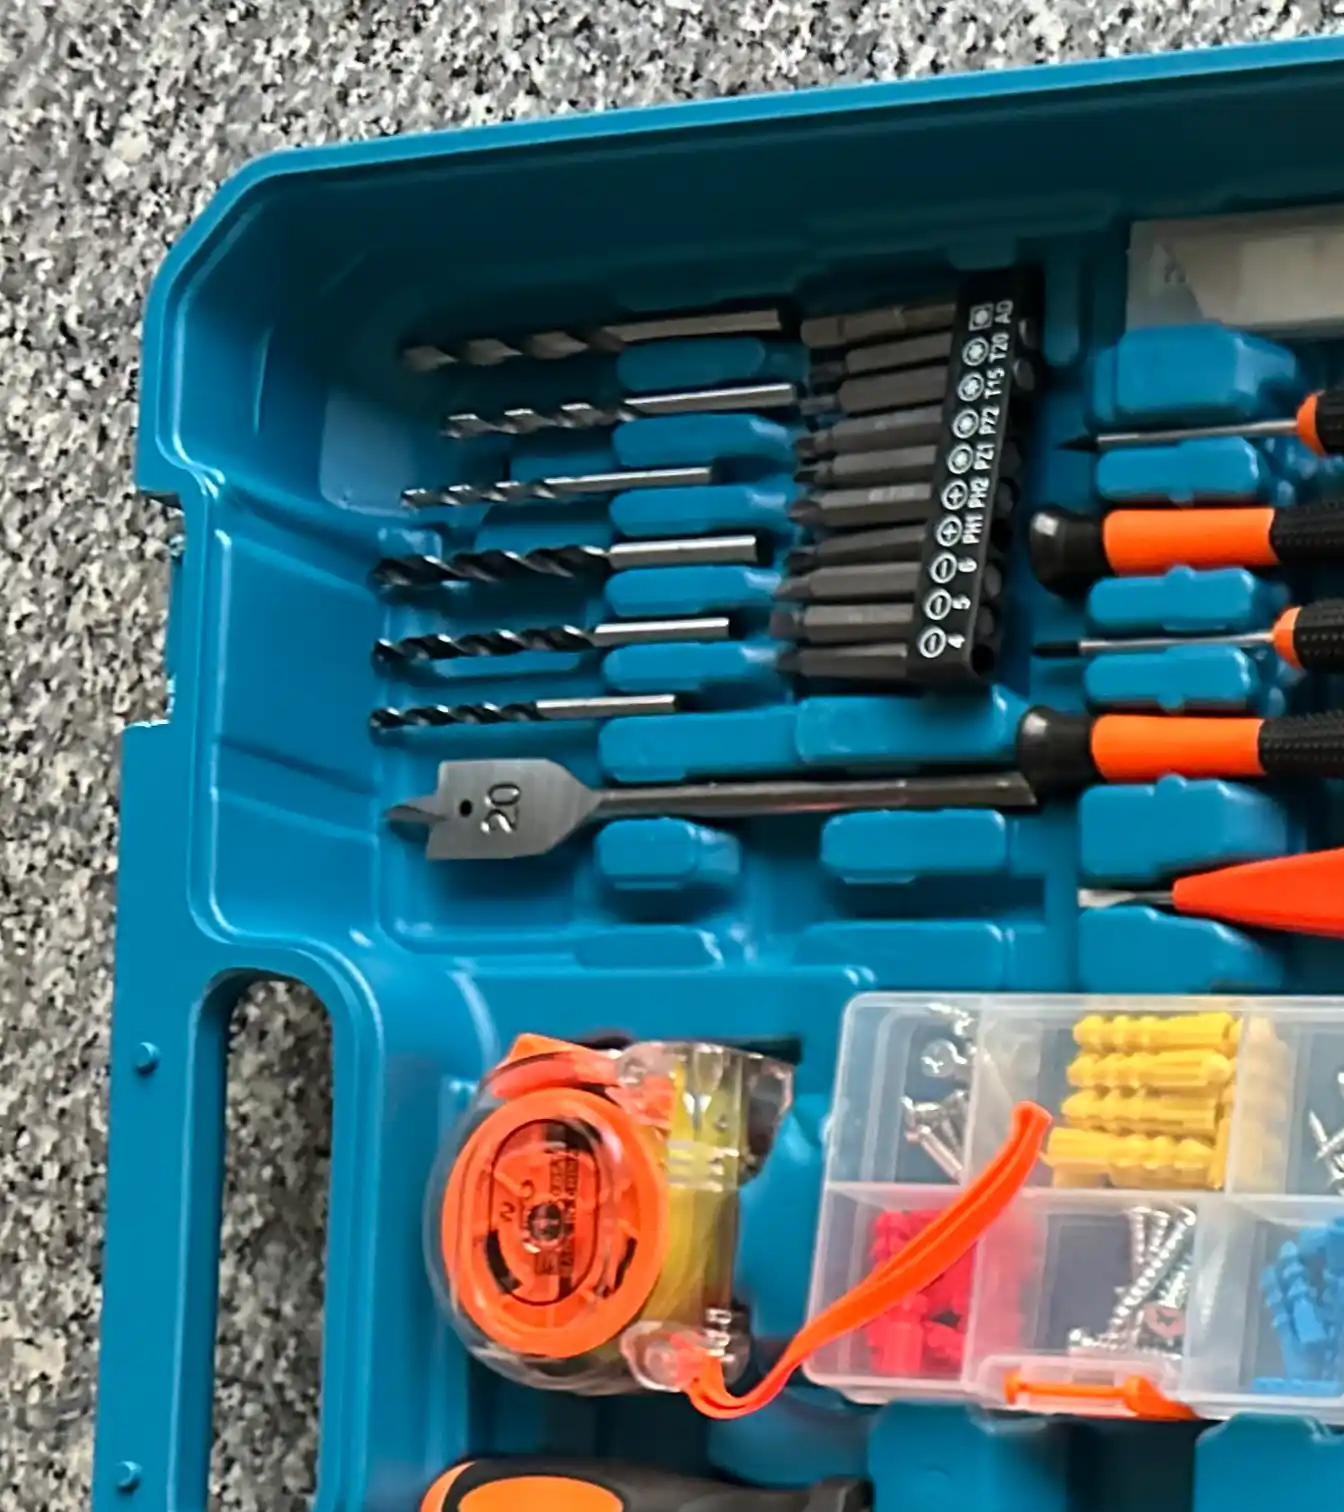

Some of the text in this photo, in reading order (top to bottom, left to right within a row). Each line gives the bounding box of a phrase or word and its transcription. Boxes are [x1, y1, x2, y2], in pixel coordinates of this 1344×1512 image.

[989, 332, 1009, 364] T20
[984, 368, 1005, 399] T15
[973, 443, 996, 471] PZ1
[967, 476, 990, 508] PH2
[962, 511, 984, 544] PH1
[947, 632, 966, 648] 4
[481, 782, 521, 835] 20
